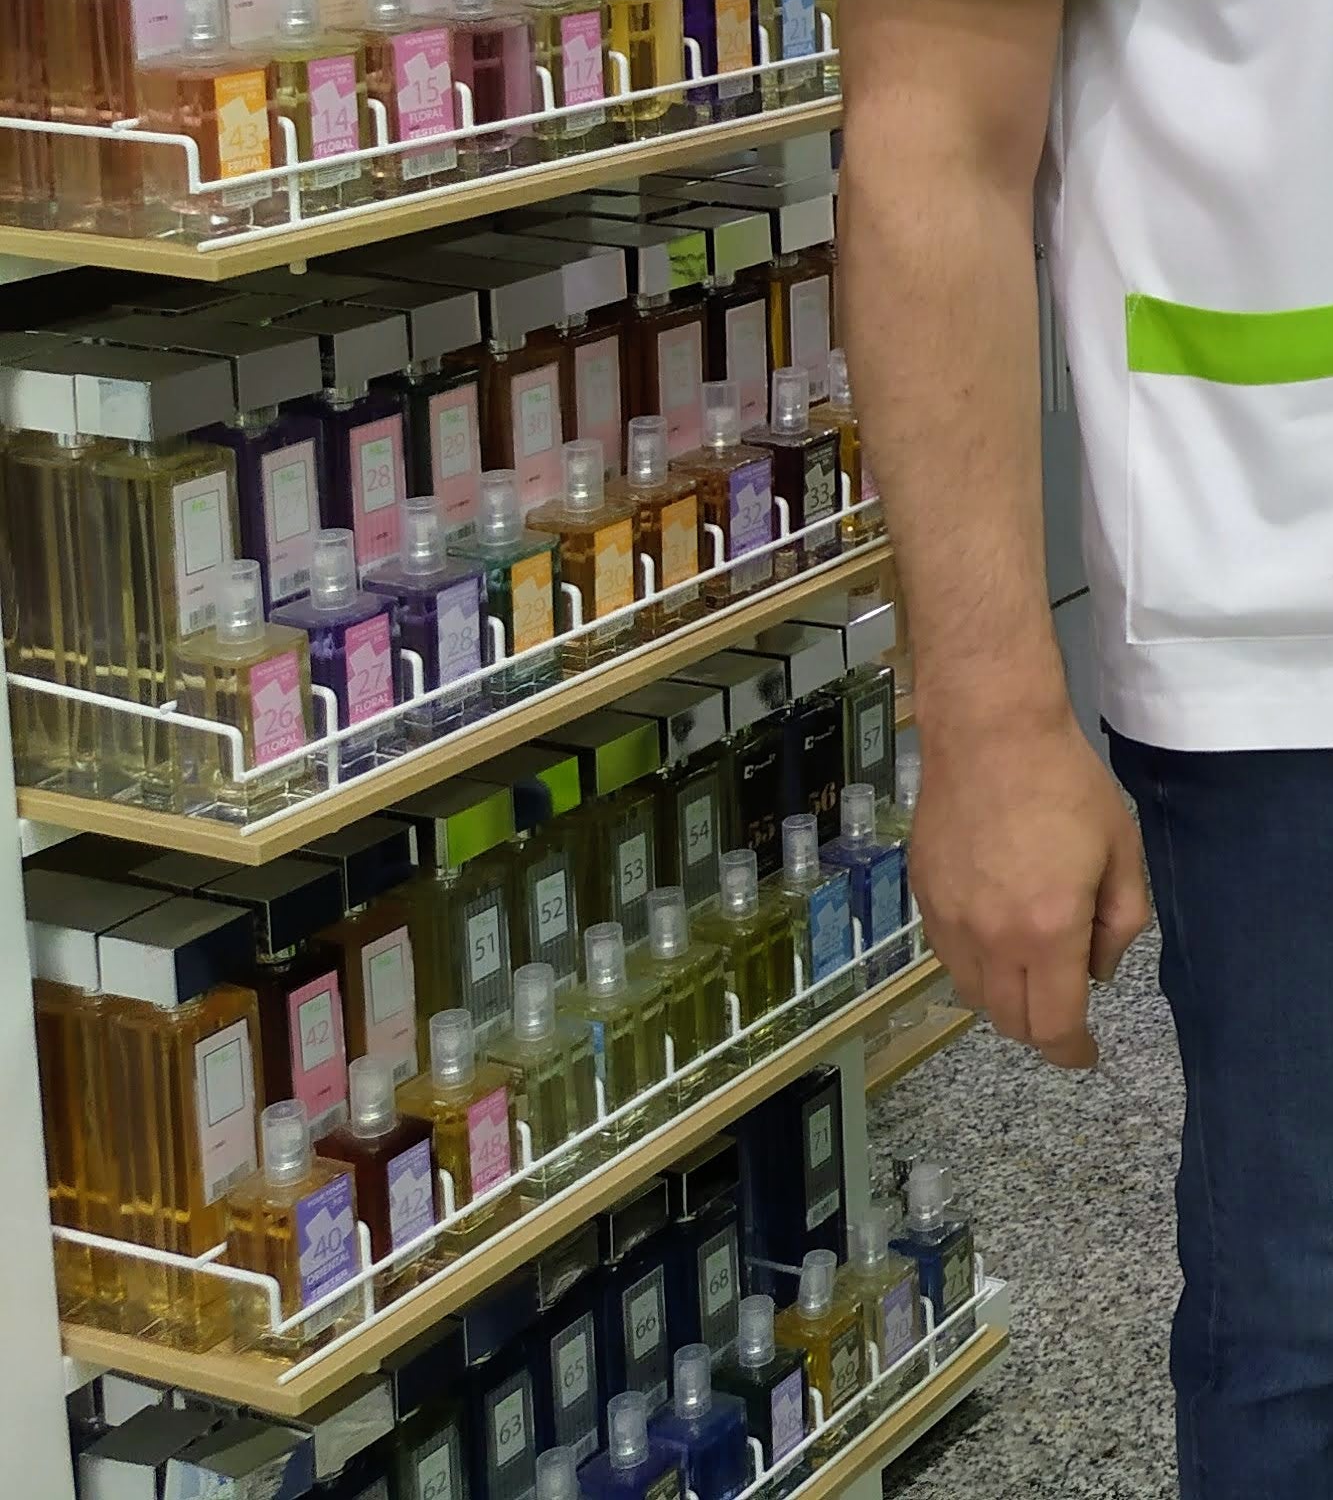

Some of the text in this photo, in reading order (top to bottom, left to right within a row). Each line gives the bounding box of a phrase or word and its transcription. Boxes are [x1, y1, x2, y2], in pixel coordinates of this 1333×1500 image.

[790, 18, 809, 41] 21
[573, 57, 595, 82] 17
[415, 76, 439, 104] 15
[323, 108, 350, 134] 14
[409, 107, 444, 124] FLORAL
[229, 123, 260, 150] 43
[318, 138, 354, 155] FLORAL
[366, 465, 392, 492] 28
[809, 482, 832, 508] 33
[741, 503, 762, 529] 32
[448, 627, 472, 651] 28
[359, 663, 383, 692] 27
[354, 693, 389, 715] FLORAL
[264, 706, 294, 736] 26
[261, 731, 300, 757] FLORAL
[863, 726, 882, 749] 57
[688, 823, 709, 848] 54
[622, 857, 645, 884] 53
[540, 893, 565, 925] 52
[474, 932, 496, 963] 51
[304, 1019, 330, 1048] 42
[476, 1138, 501, 1165] 48
[812, 1131, 830, 1156] 71
[399, 1188, 425, 1213] 42
[314, 1228, 342, 1259] 40
[709, 1268, 730, 1296] 68
[634, 1314, 657, 1339] 66
[563, 1359, 585, 1388] 65
[836, 1363, 857, 1388] 69
[499, 1415, 522, 1443] 63
[423, 1470, 447, 1500] 62
